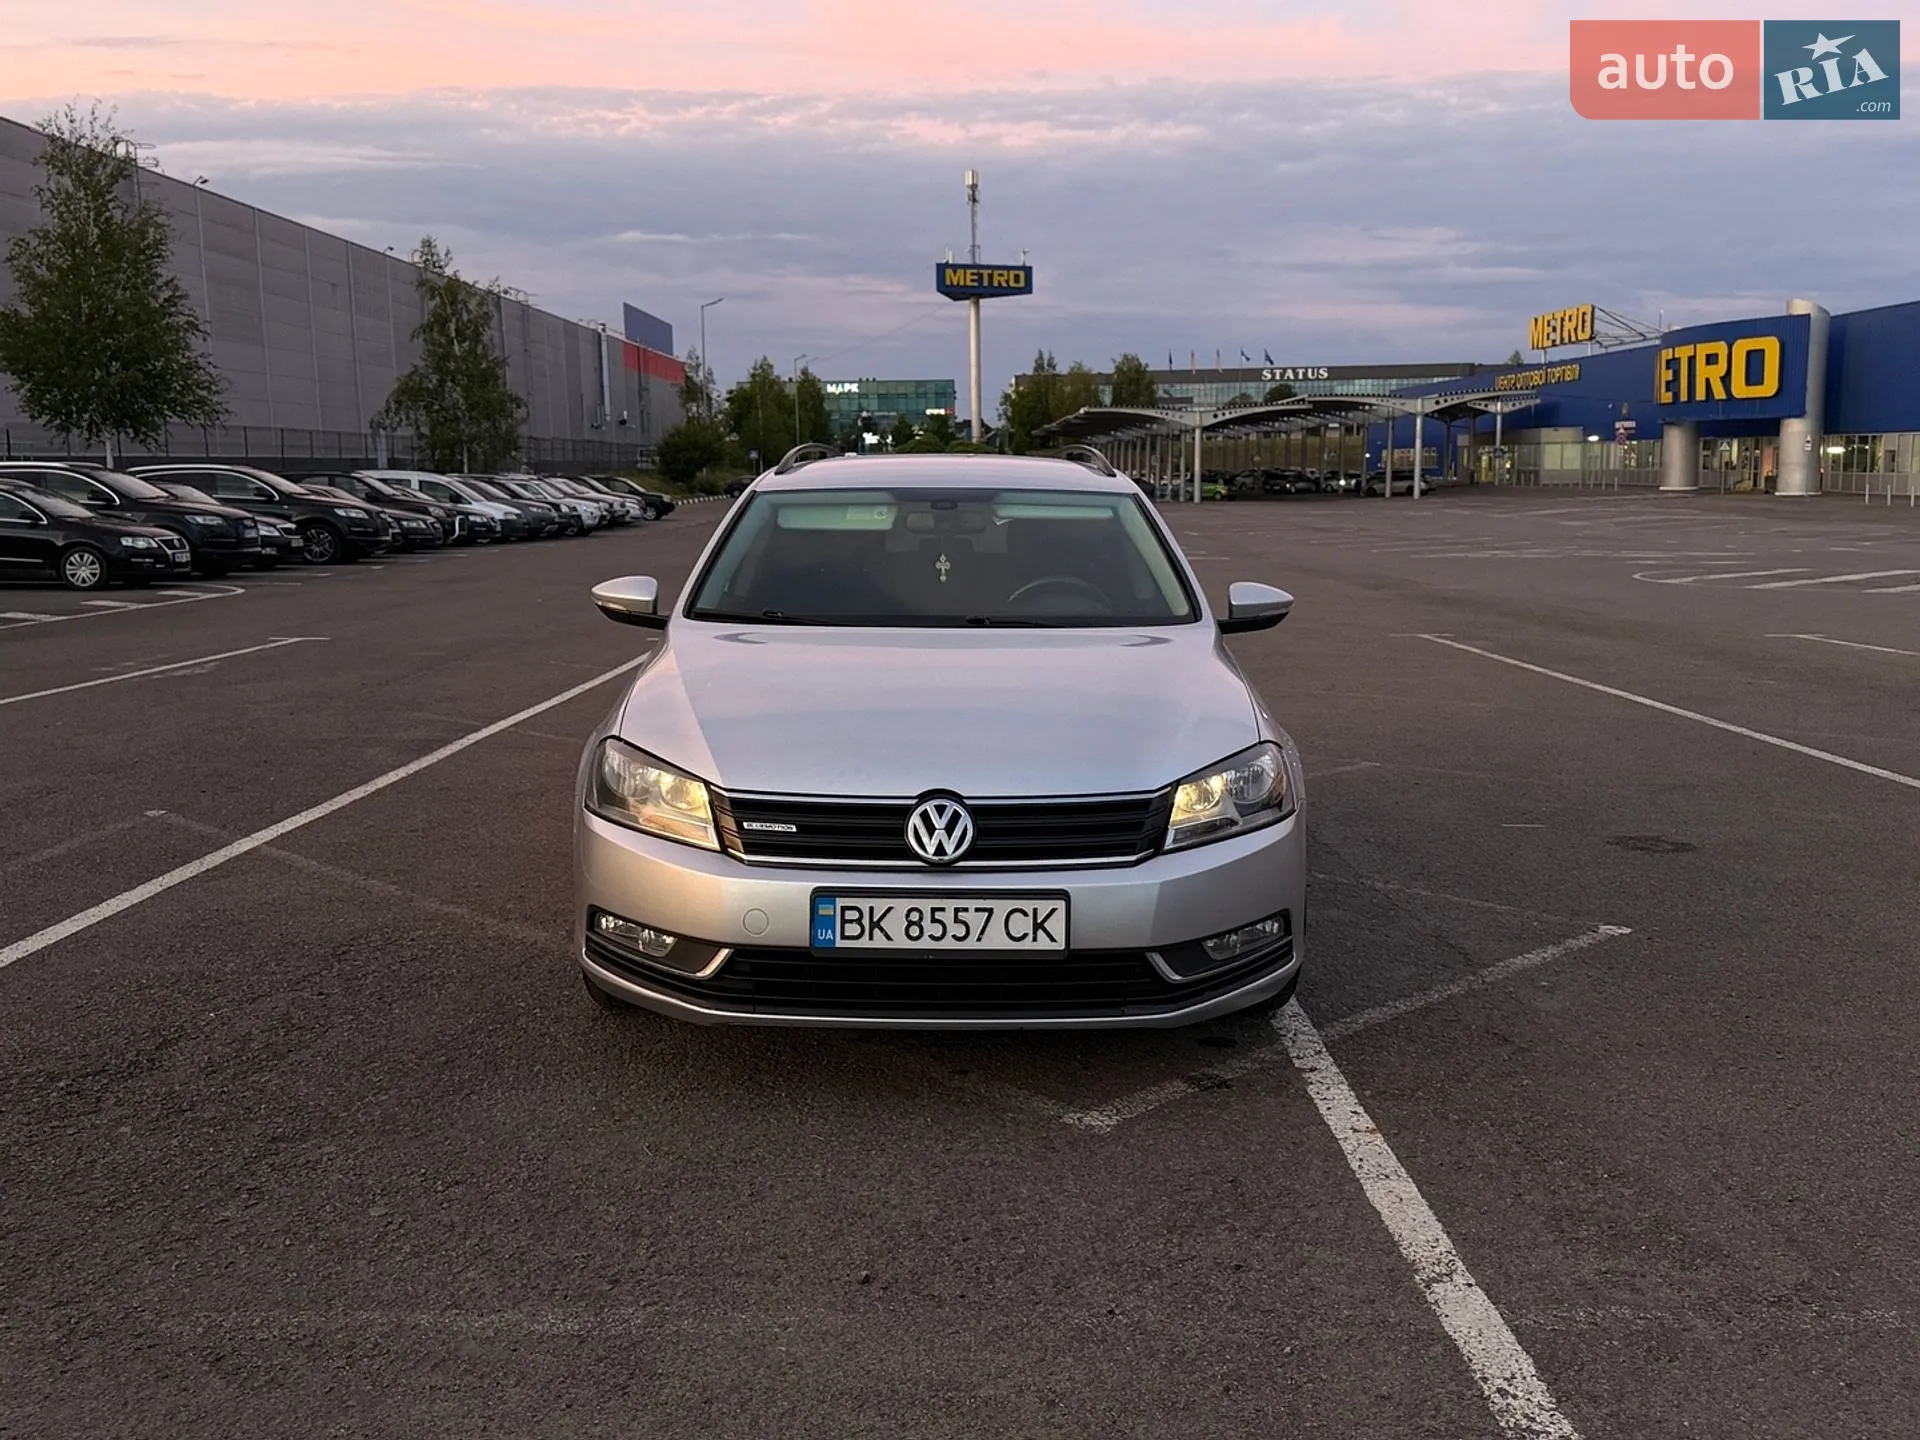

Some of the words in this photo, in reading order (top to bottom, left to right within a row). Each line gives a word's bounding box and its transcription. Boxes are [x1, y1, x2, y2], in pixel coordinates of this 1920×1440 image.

[945, 268, 1026, 288] METRO
[1528, 303, 1594, 350] METRO
[1261, 367, 1329, 380] STATUS
[1655, 336, 1781, 405] ETRO
[817, 928, 834, 941] UA
[840, 905, 894, 941] BK
[904, 906, 995, 943] 8557
[1003, 907, 1059, 943] CK
